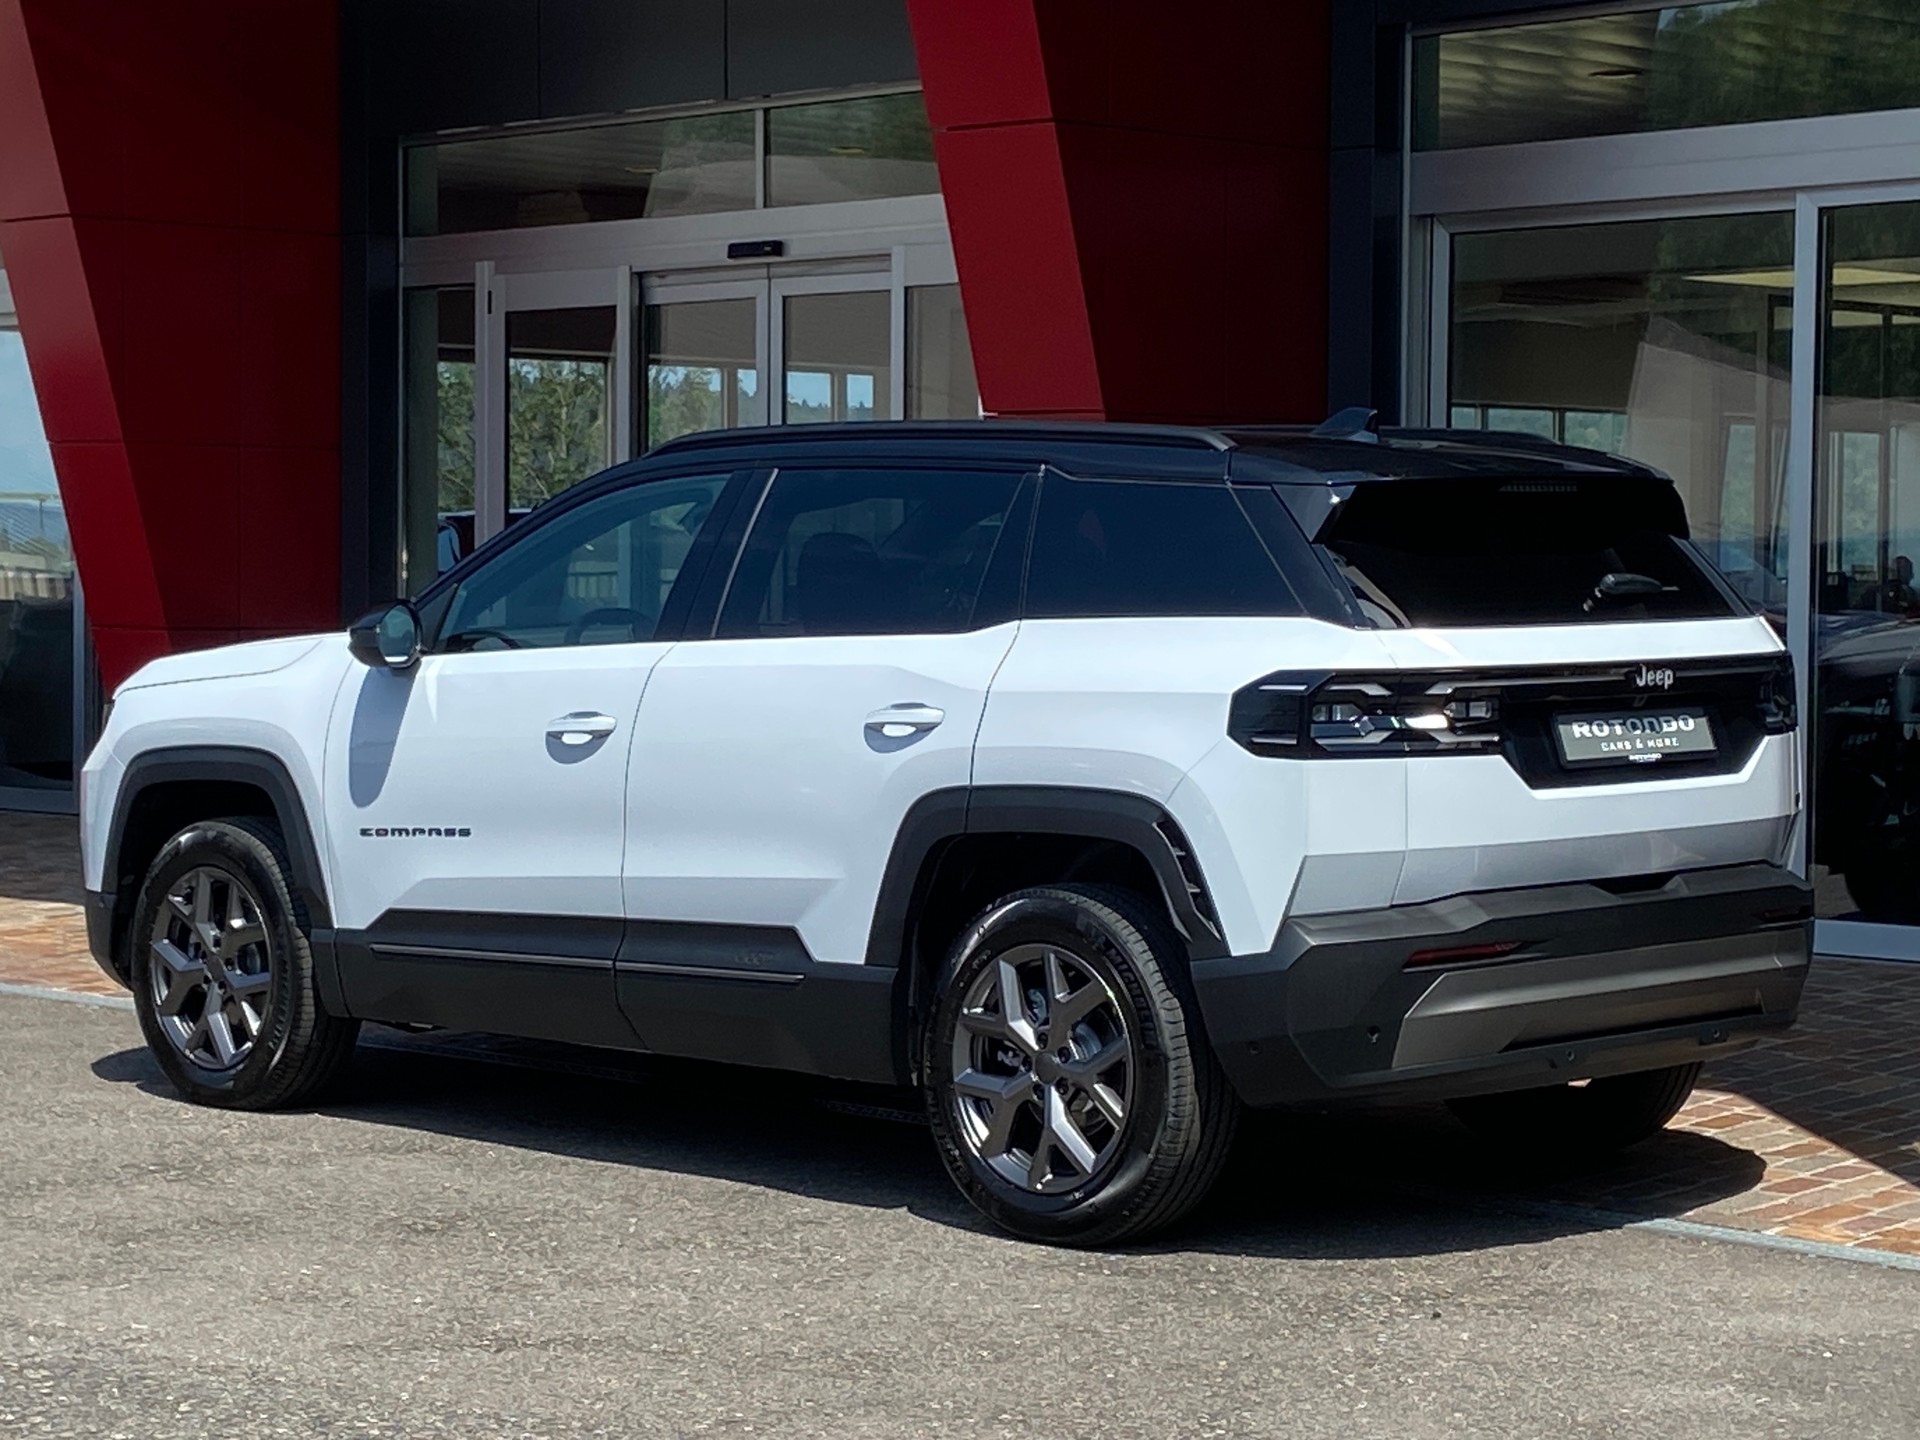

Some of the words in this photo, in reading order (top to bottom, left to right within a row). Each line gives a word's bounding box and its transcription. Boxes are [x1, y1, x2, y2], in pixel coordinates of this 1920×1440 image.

[1635, 664, 1673, 689] Jeep
[1571, 714, 1695, 738] ROTONDO
[1601, 741, 1632, 751] CARS
[1636, 739, 1644, 749] &
[1648, 737, 1679, 748] MORE
[360, 827, 471, 837] COMPASS
